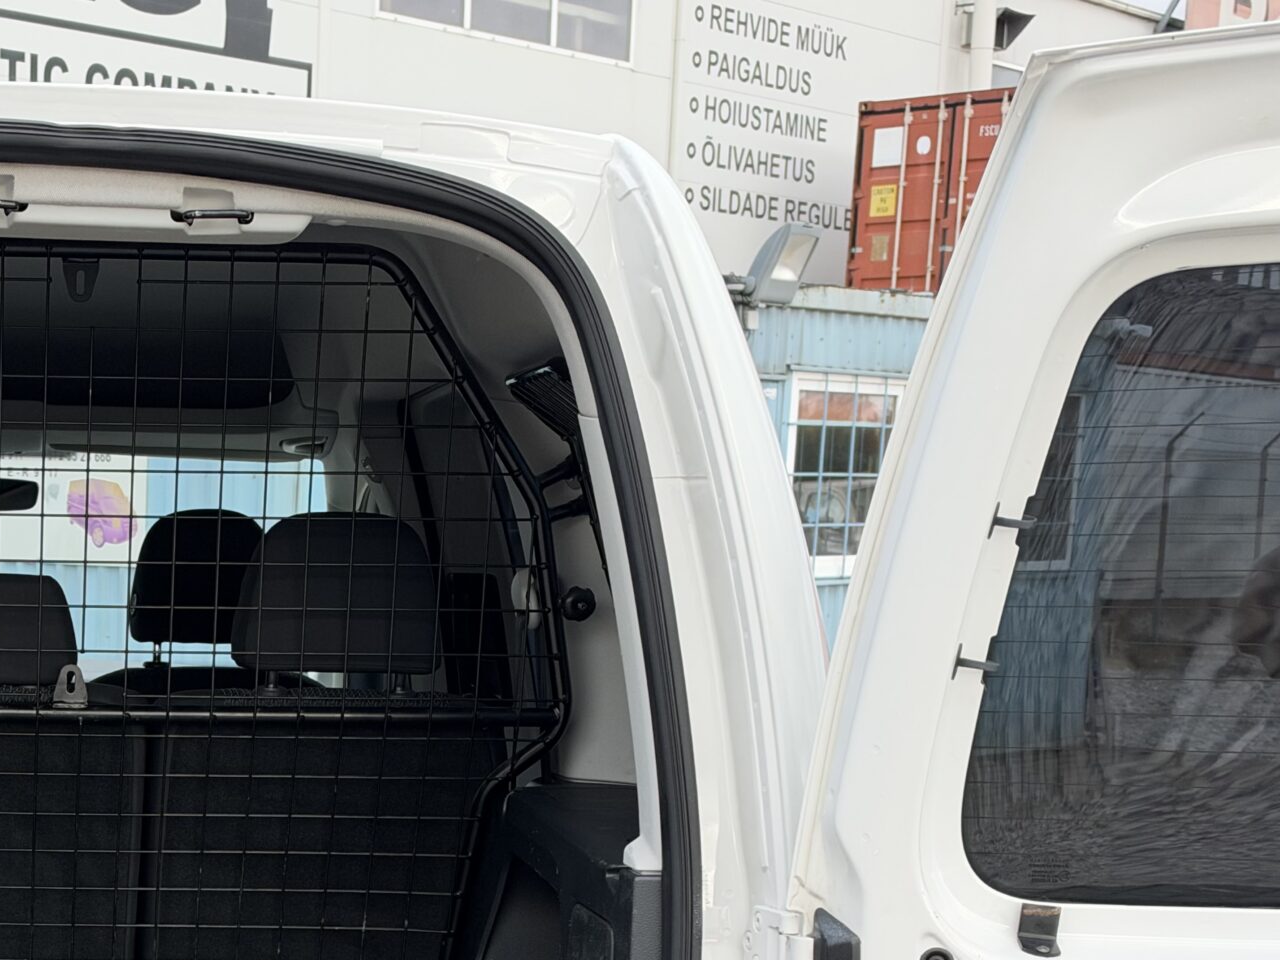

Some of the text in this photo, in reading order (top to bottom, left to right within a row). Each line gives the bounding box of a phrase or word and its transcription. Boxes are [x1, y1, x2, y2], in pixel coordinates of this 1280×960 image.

[710, 4, 847, 61] REHVIDE MÜÜK
[707, 50, 812, 96] PAIGALDUS
[704, 95, 828, 143] HOIUSTAMINE
[702, 135, 816, 184] ÕLIVAHETUS
[699, 185, 779, 221] SILDADE
